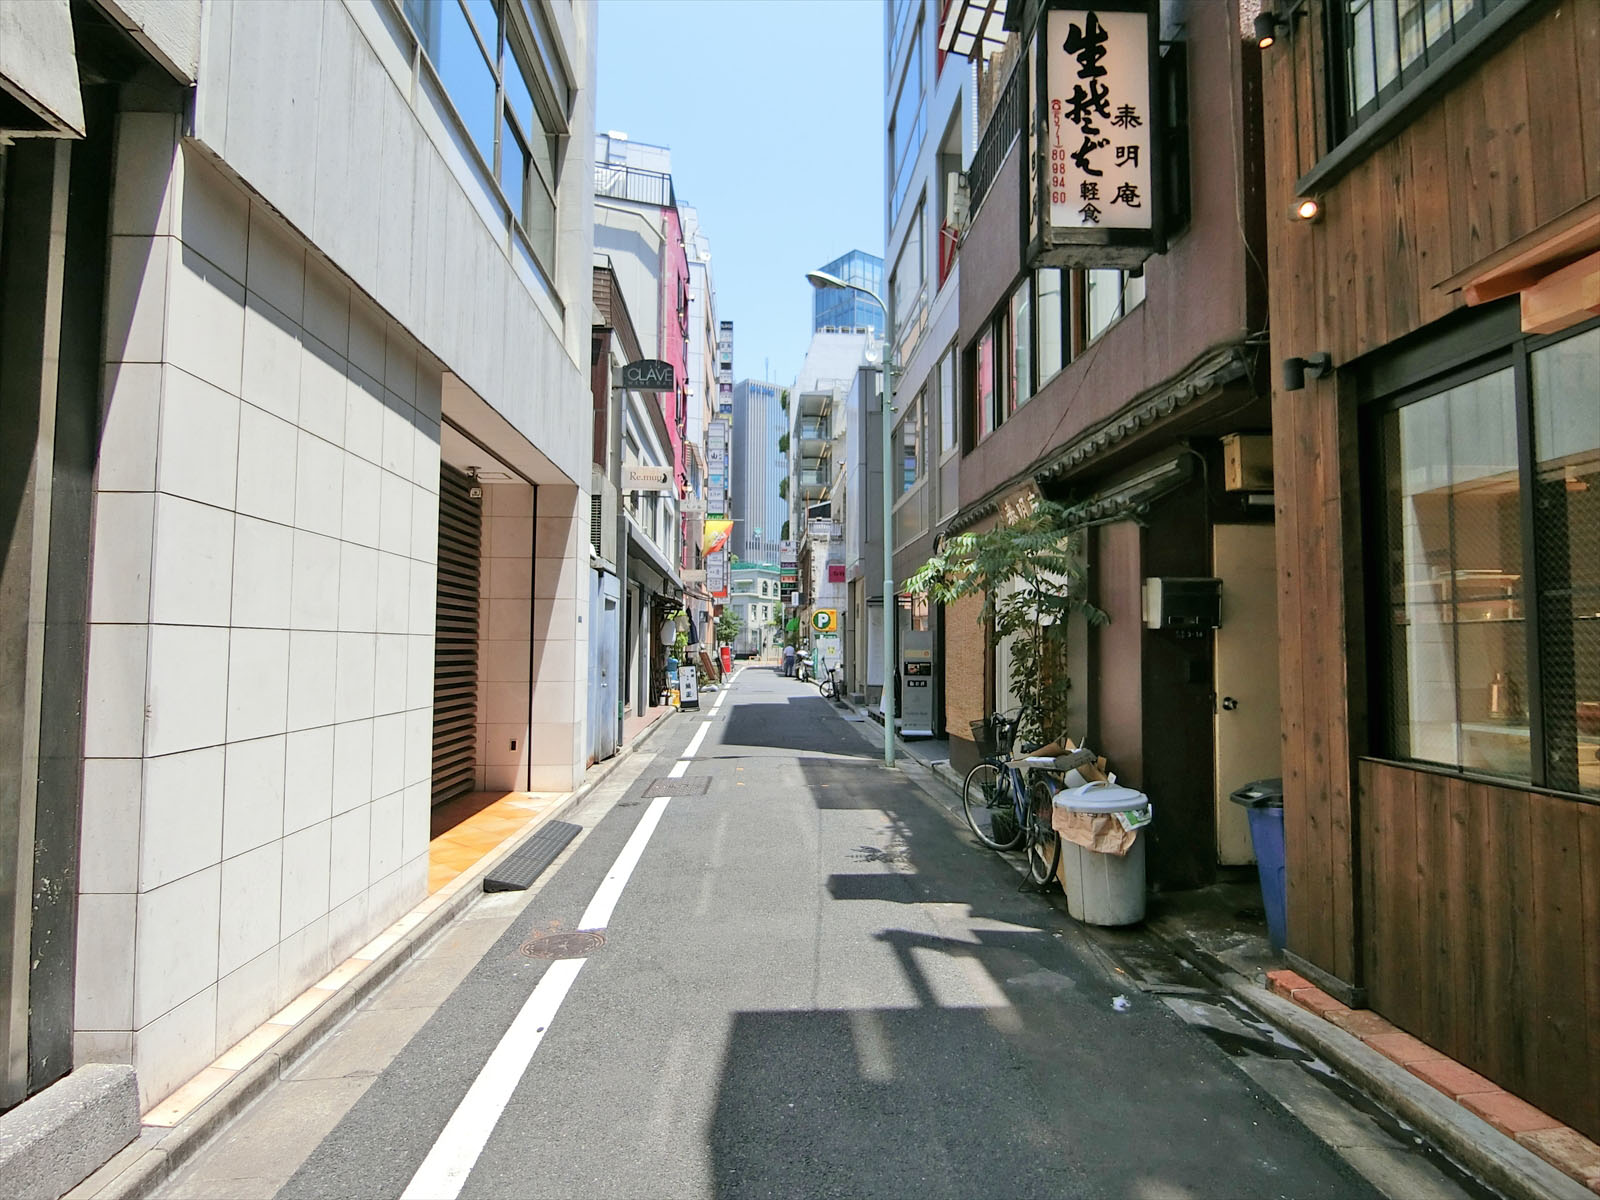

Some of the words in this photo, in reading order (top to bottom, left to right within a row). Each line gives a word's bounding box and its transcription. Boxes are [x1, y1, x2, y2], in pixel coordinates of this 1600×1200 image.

[1110, 103, 1143, 208] 泰明庵
[1078, 179, 1102, 224] 軽食
[627, 367, 673, 382] CLAVE
[817, 613, 829, 628] P
